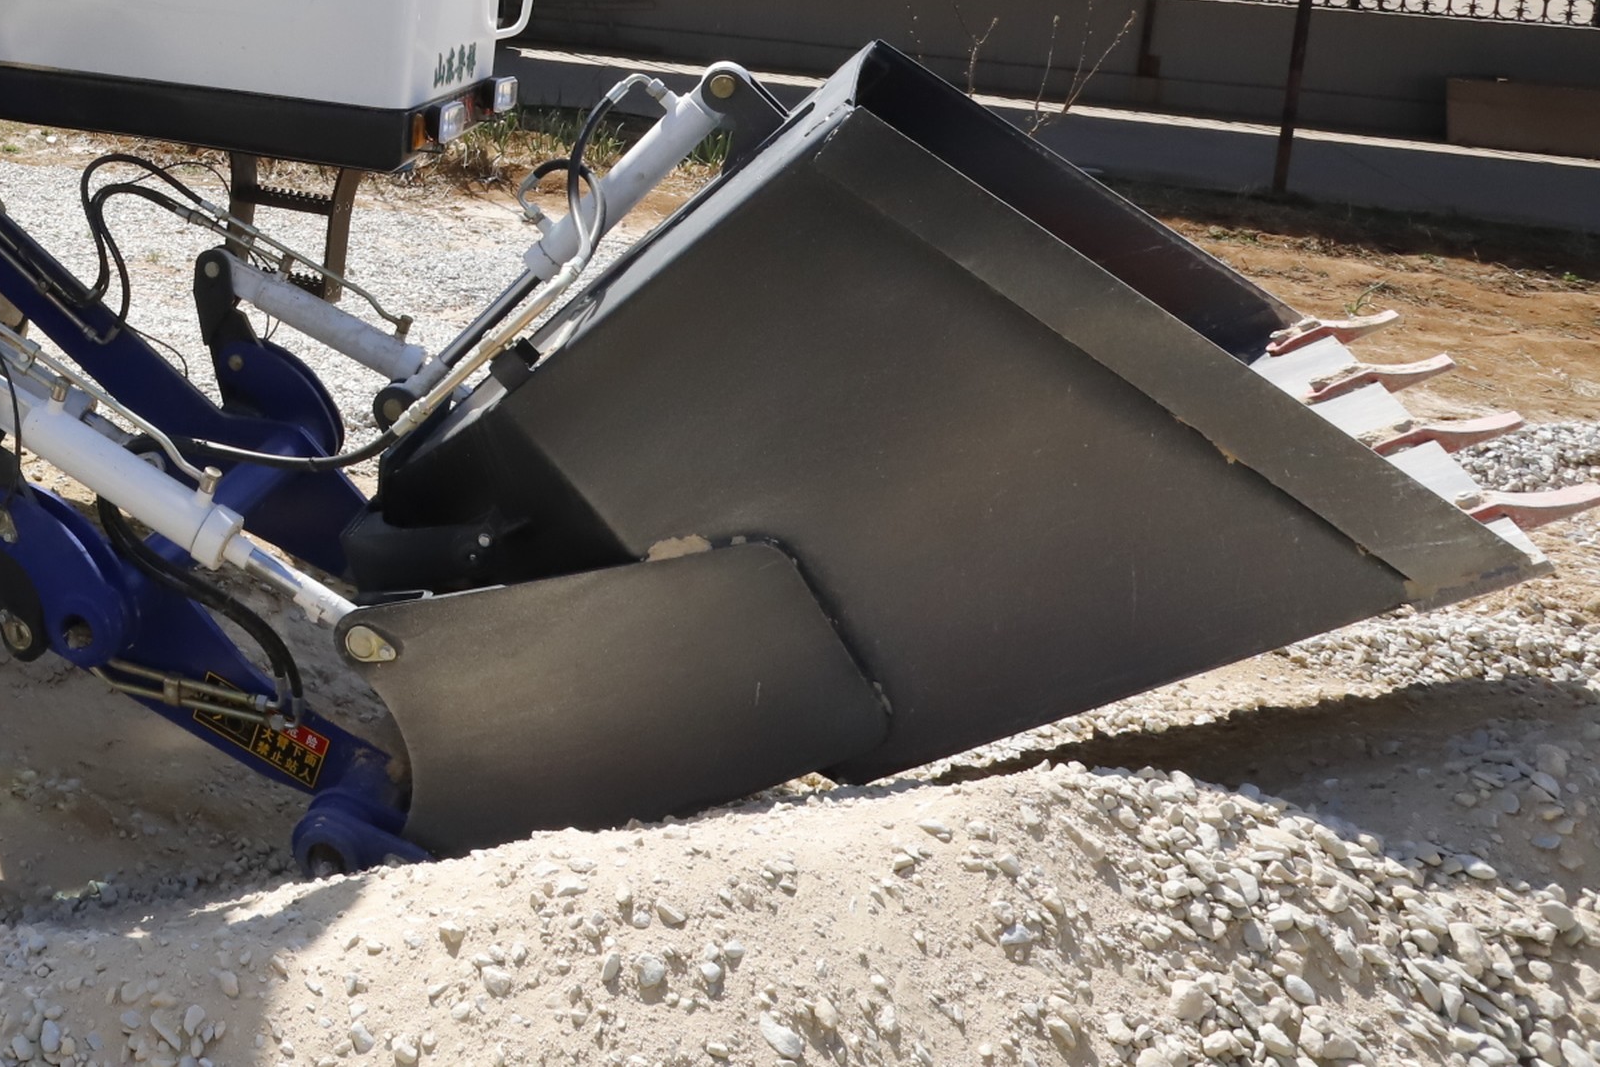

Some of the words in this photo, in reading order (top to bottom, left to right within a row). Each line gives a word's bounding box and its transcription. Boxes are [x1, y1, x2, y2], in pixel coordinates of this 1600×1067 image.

[256, 741, 312, 782] 禁止站人
[261, 728, 319, 768] 大臂下面
